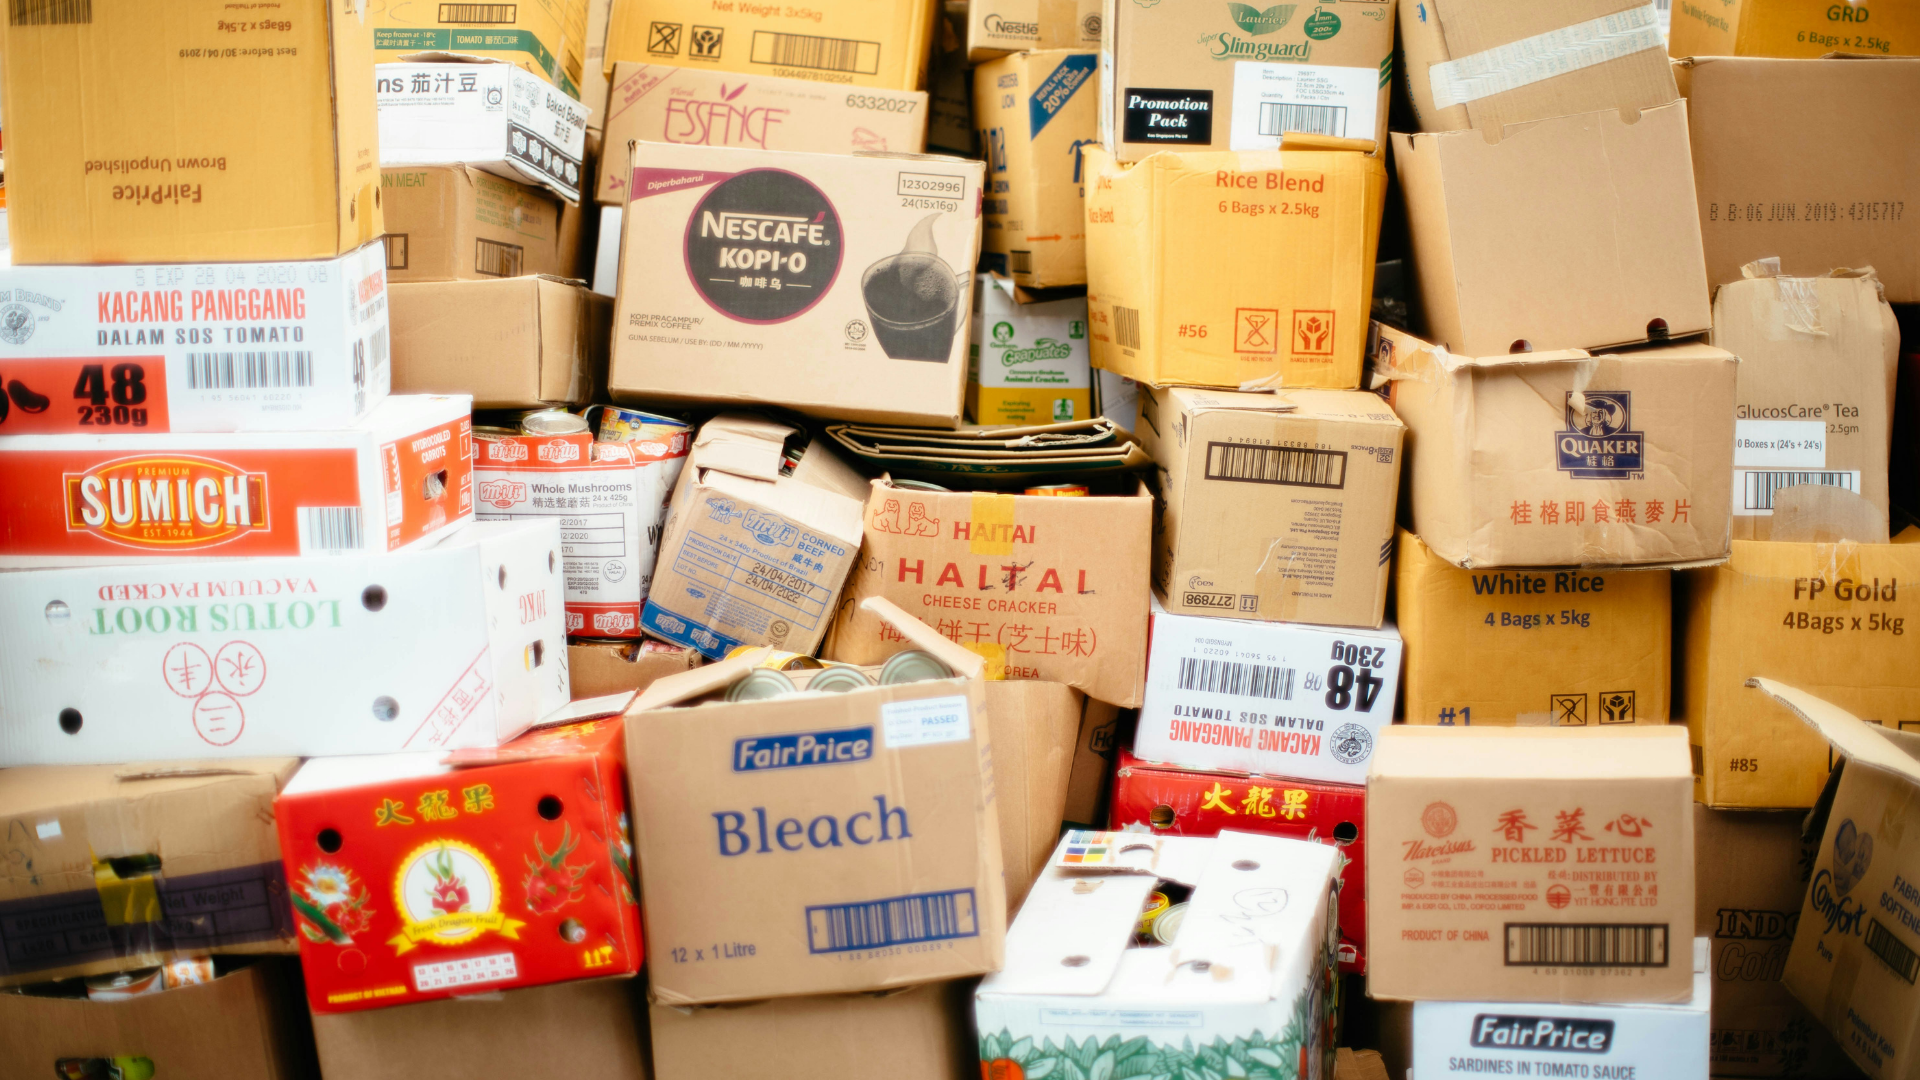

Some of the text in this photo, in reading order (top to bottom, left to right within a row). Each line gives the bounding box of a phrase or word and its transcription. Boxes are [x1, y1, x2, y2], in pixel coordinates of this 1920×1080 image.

[712, 0, 822, 22] Net Weight 3x5kg
[1237, 11, 1287, 26] Laurier
[1826, 4, 1870, 23] GRD
[217, 20, 292, 34] 6Bags 2.5kg
[376, 31, 412, 40] Keep frozen
[456, 35, 483, 45] TOMATO
[1211, 32, 1310, 60] Slimguard
[1798, 30, 1892, 52] 6 Bags 2.5kg
[238, 48, 297, 57] Best Before:
[410, 72, 478, 94] 茄汁豆
[1036, 65, 1071, 102] REFILL PACK
[846, 94, 917, 114] 6332027
[1042, 84, 1071, 114] 20%
[1128, 94, 1208, 111] Promotion
[1148, 112, 1188, 128] Pack
[84, 157, 227, 176] Brown Unpolished
[396, 173, 428, 188] MEAT
[646, 173, 705, 191] Diperbaharui
[901, 178, 961, 194] 12302996
[1216, 170, 1325, 193] Rice Blend
[111, 184, 202, 206] FairPrice
[900, 198, 958, 213] 24(15x16g)
[1099, 206, 1114, 224] Blend
[1218, 200, 1320, 219] 6 Bags 2.5kg
[701, 210, 825, 247] NESCAFÉ
[718, 246, 808, 274] KOPI-O
[256, 266, 298, 284] 2020
[98, 287, 306, 324] KACANG PANGGANG
[629, 320, 692, 330] PREMIX COFFEE
[630, 312, 704, 326] KOPI PRACAMPUR/
[97, 326, 305, 346] DALAM SOS TOMATO
[628, 334, 678, 344] GUNA SEBELUM
[1178, 324, 1208, 339] #56
[72, 363, 147, 406] 48
[1034, 376, 1070, 384] Crackers
[77, 406, 148, 428] 230g
[1833, 403, 1859, 418] Tea
[1830, 424, 1860, 436] 2.5gm
[412, 429, 451, 454] HYDROCOOLED
[1560, 437, 1639, 456] QUAKER
[1744, 439, 1796, 452] Boxes (24's
[422, 446, 446, 464] CARROTS
[137, 467, 190, 476] PREMIUM
[532, 482, 633, 494] Whole Mushrooms
[79, 474, 250, 529] SUMICH
[532, 496, 590, 509] 精选整蘑菇
[592, 494, 628, 503] 24 425g
[952, 520, 1036, 544] HAITAI
[688, 536, 738, 562] PRODUCTION DATE
[797, 542, 826, 560] BEEF
[801, 532, 846, 558] CORNED
[98, 576, 319, 602] VACUUM PACKED
[744, 574, 801, 604] 24/04/2022
[752, 562, 816, 596] 24/04/2017
[1471, 572, 1605, 595] White Rice
[1186, 594, 1233, 607] 277898
[1794, 578, 1898, 603] FP Gold
[519, 588, 548, 626] 10KG
[922, 594, 1058, 615] CHEESE CRACKER
[88, 599, 343, 636] LOTUS ROOT
[1484, 610, 1591, 630] 4 Bags 5kg
[1782, 612, 1905, 636] 4Bags x 5kg
[1330, 640, 1387, 670] 230g
[994, 664, 1040, 679] KOREA
[1324, 664, 1385, 714] 48
[921, 713, 959, 726] PASSED
[1173, 704, 1324, 732] TOMATO SOS DALAM
[1169, 718, 1322, 756] PANGGANG KACANG
[738, 732, 870, 770] FairPrice
[1730, 758, 1758, 772] #85
[374, 783, 497, 828] 火龍果
[1200, 782, 1310, 821] 火龍果
[710, 793, 913, 857] Bleach
[1492, 806, 1654, 845] 香菜心
[1402, 838, 1478, 862] Narcissus
[1490, 846, 1657, 864] PICKLED LETTUCE
[1572, 870, 1658, 882] DISTRIBUTED BY
[1590, 898, 1658, 907] HONG LTD
[1811, 868, 1868, 937] Comfort
[412, 914, 498, 936] Fresh Dragon Fruit
[1402, 930, 1490, 942] PRODUCT OF CHINA
[670, 941, 757, 964] 12 Litre
[1817, 940, 1834, 964] Pure
[328, 984, 406, 1004] PRODUCT VIETNAM
[1477, 1018, 1606, 1050] FairPrice
[1449, 1056, 1637, 1080] SARDINES IN TOMATO SAUCE
